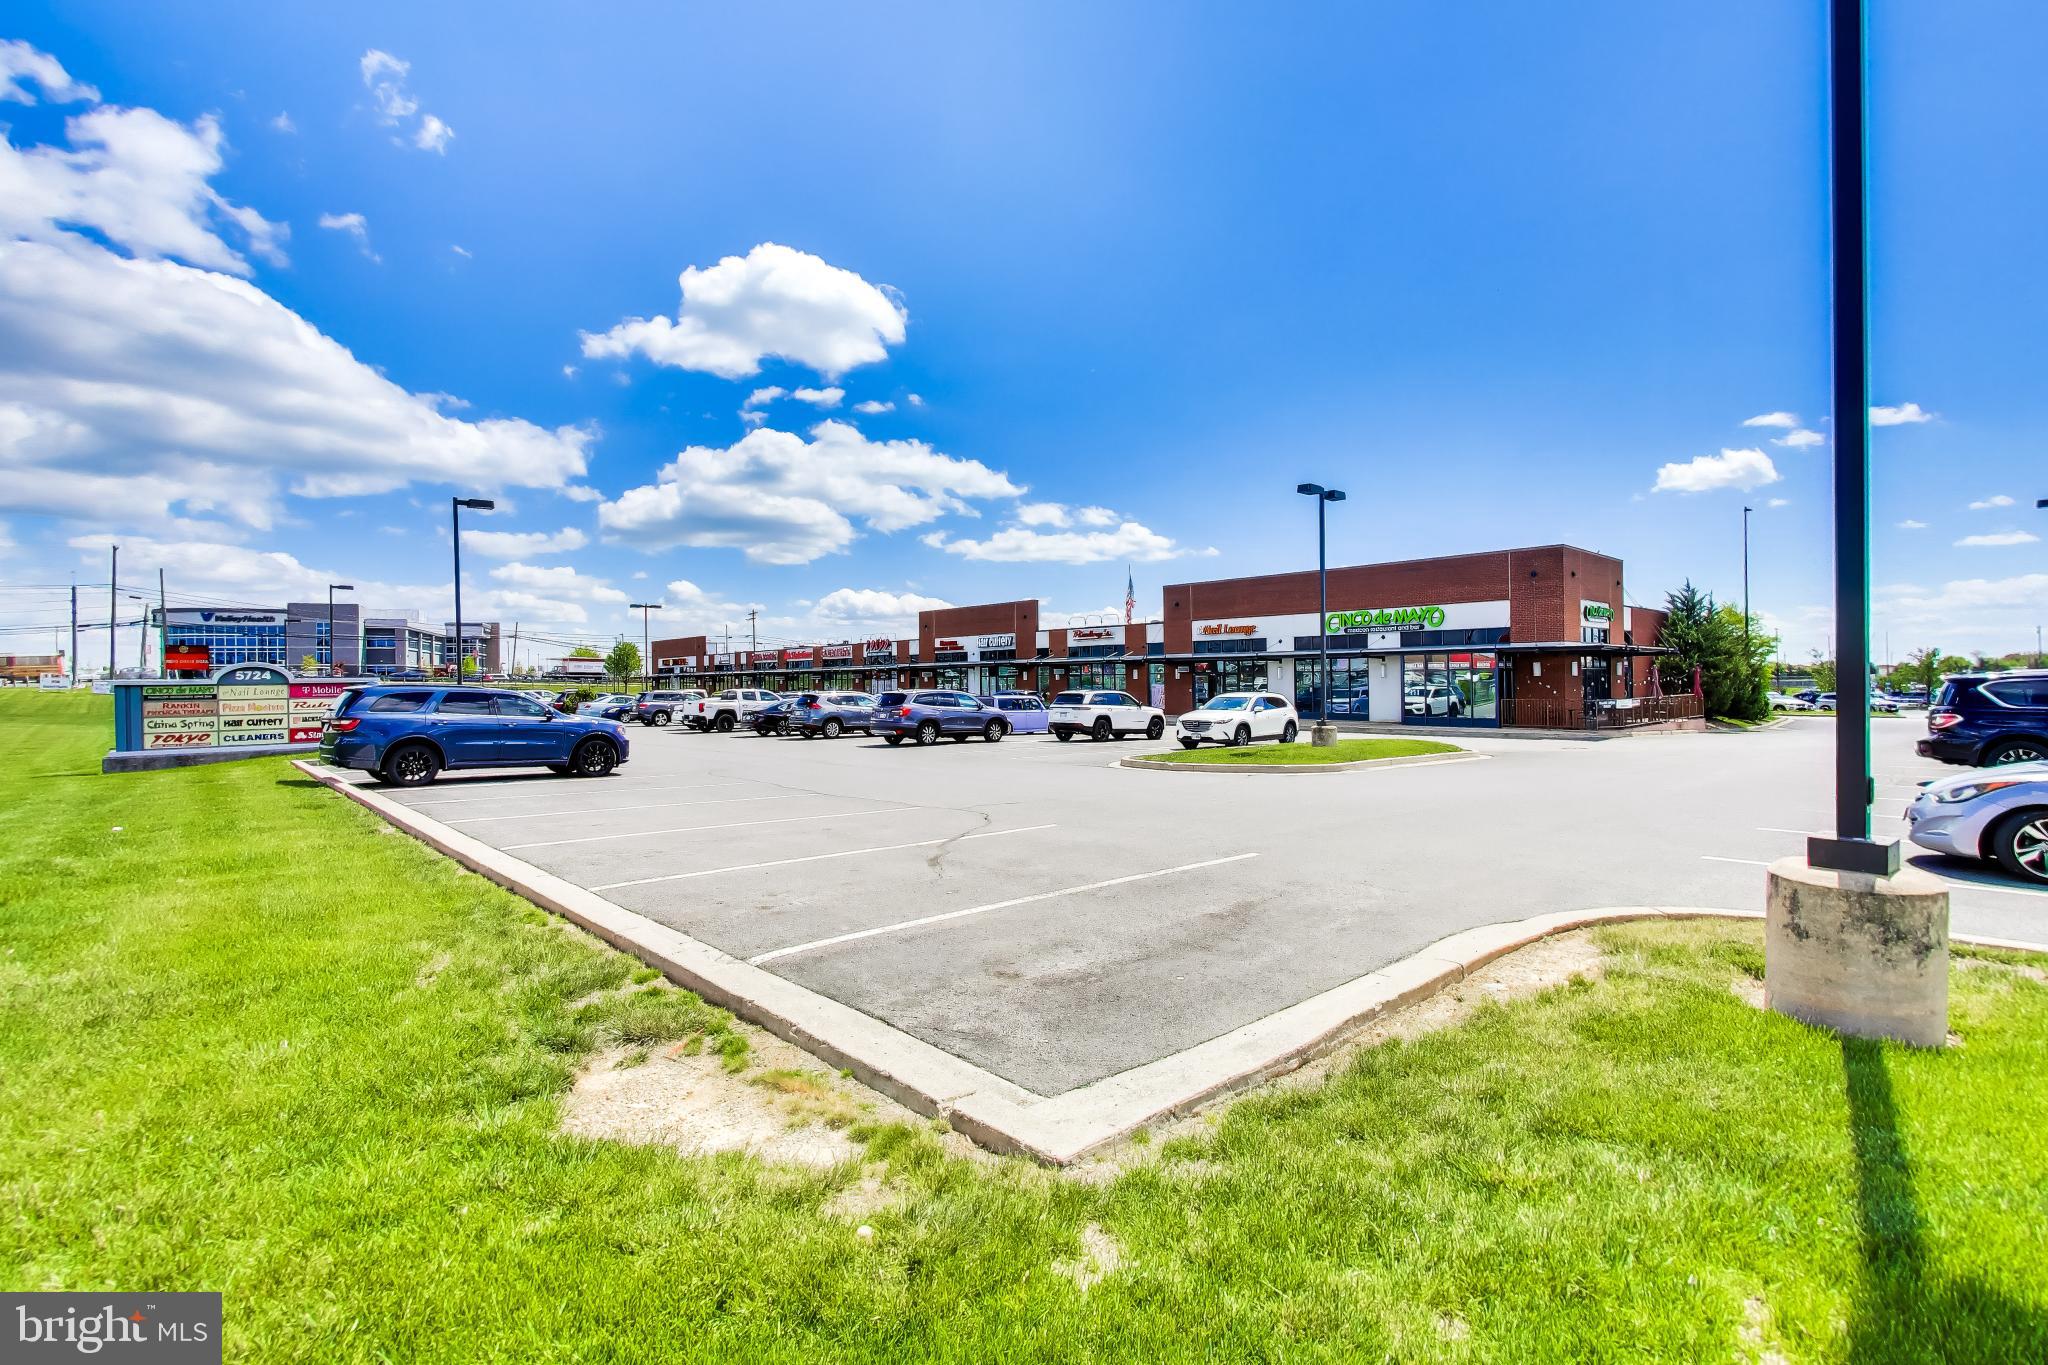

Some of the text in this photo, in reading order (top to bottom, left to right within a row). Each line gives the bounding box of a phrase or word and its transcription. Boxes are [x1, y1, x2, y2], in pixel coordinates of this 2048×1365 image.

[1326, 605, 1445, 633] CINCO de MAYO
[235, 670, 271, 680] 5724
[230, 687, 285, 696] Nail Lounge
[312, 686, 342, 694] Mobile
[146, 719, 215, 730] China Spring
[151, 733, 211, 745] TOKYO
[223, 732, 285, 742] CLEANERS
